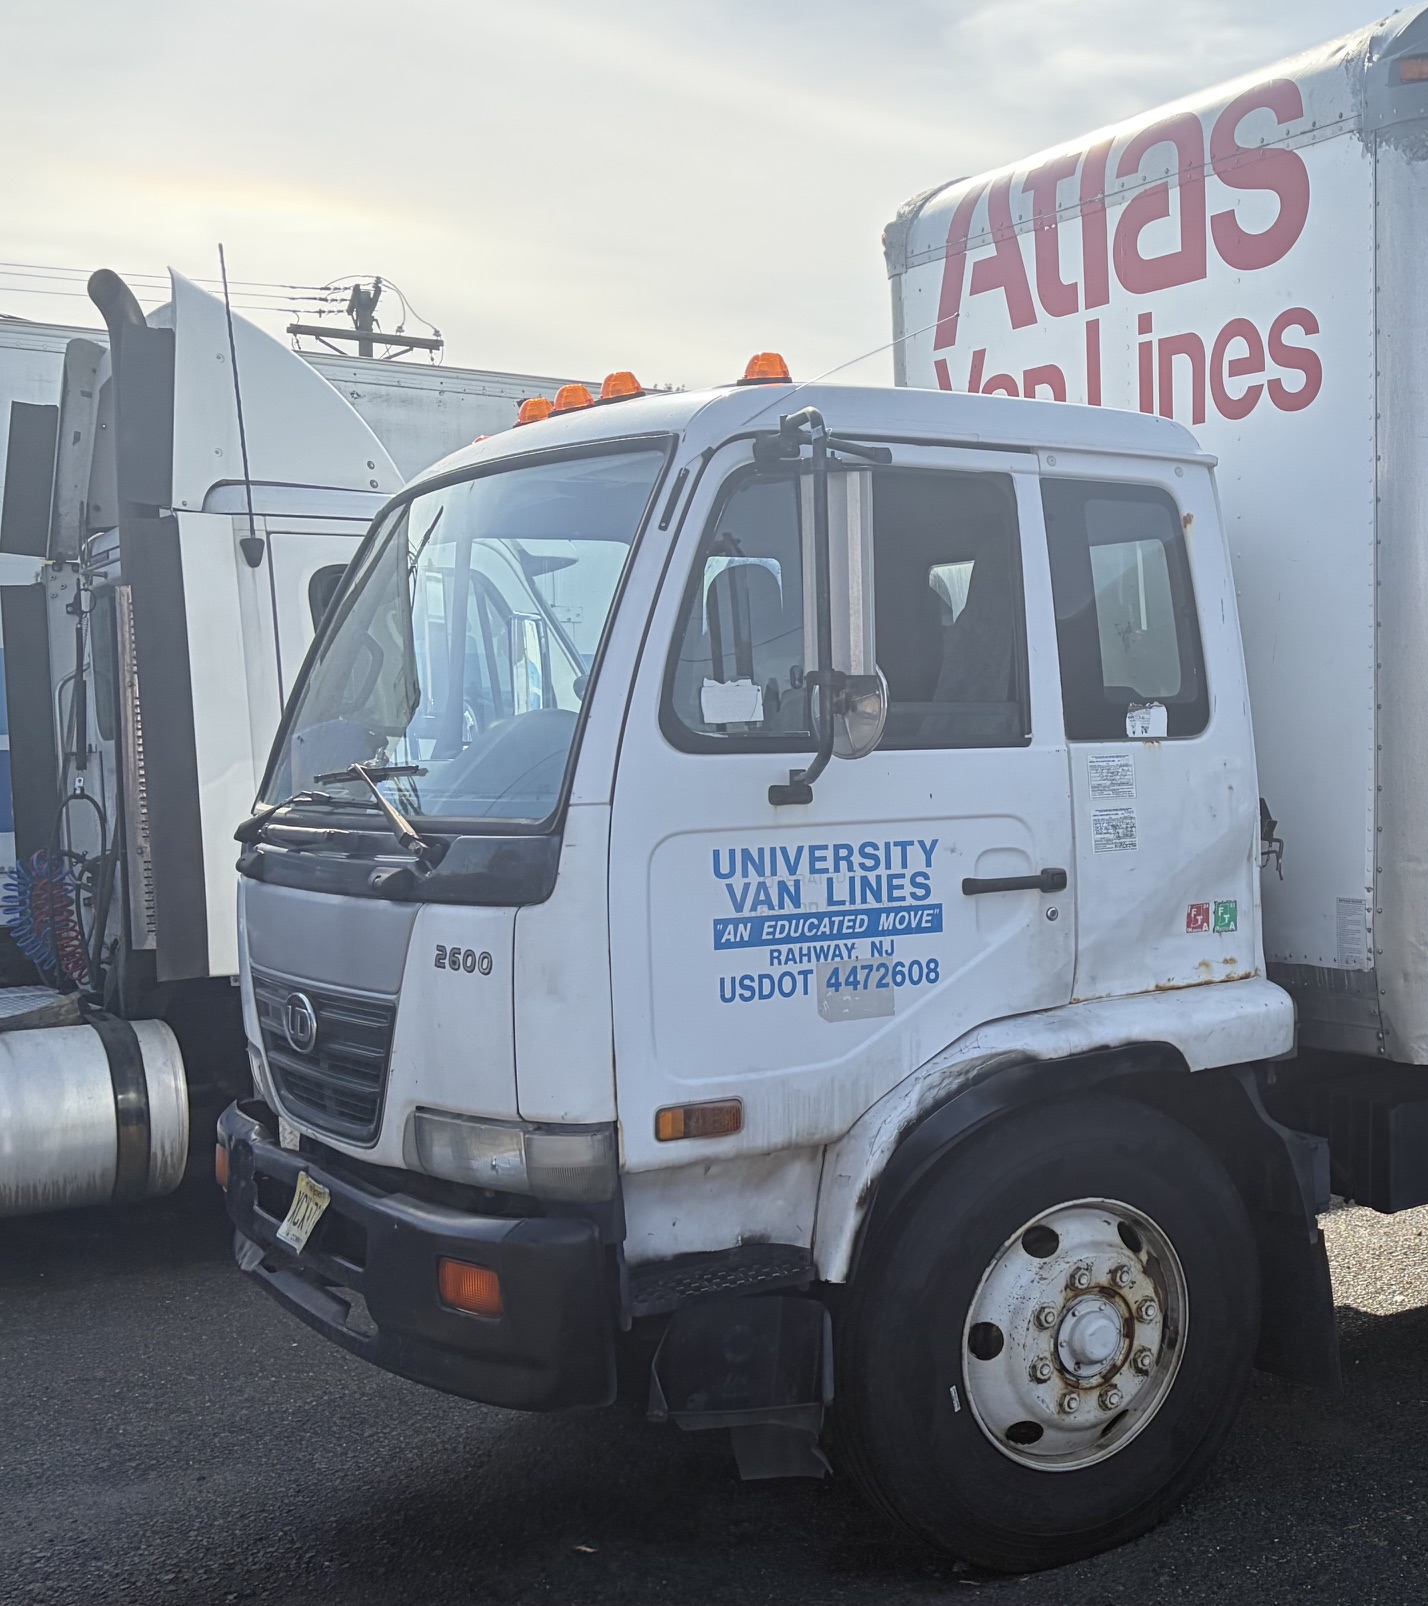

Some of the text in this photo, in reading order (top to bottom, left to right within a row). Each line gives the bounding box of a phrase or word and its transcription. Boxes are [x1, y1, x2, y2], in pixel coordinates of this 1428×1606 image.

[932, 78, 1311, 352] Atlas
[712, 839, 939, 880] UNIVERSITY
[725, 879, 802, 914] VAN
[826, 871, 932, 907] LINES
[716, 908, 940, 944] "AN EDUCATED MOVE"
[434, 944, 493, 976] 2600
[769, 939, 895, 967] RAHWAY, NJ
[719, 958, 940, 1004] USDOT 4472608
